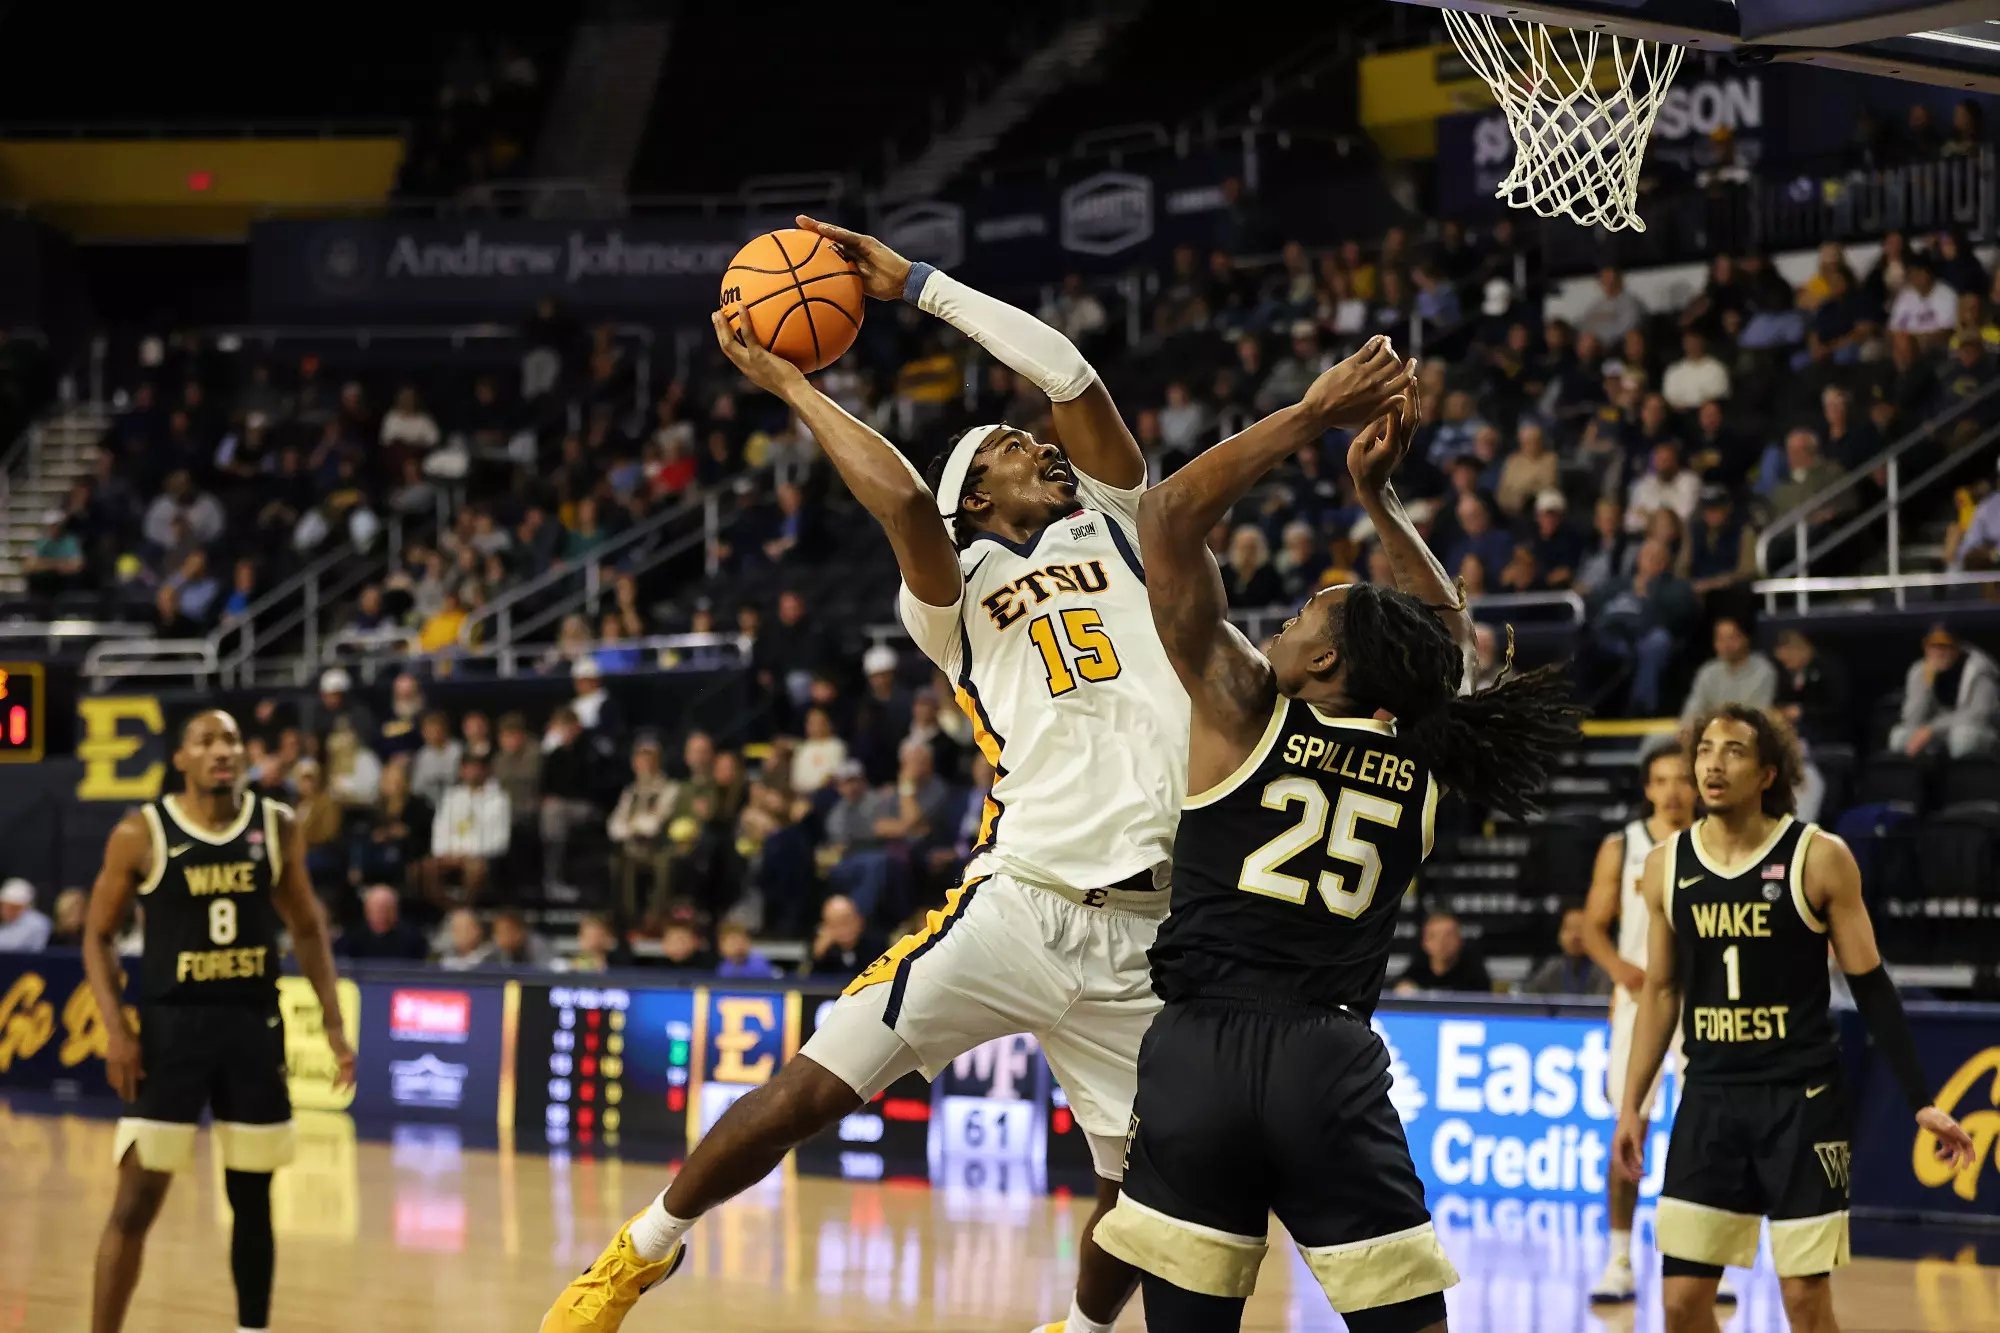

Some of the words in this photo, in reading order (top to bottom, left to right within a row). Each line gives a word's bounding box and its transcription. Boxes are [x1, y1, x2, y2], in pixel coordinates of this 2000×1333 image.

[386, 229, 562, 277] Andrew
[979, 560, 1109, 632] ETSU
[1028, 607, 1122, 698] 15
[76, 694, 166, 800] E
[1282, 733, 1416, 792] SPILLERS
[1237, 773, 1403, 920] 25
[183, 861, 257, 897] WAKE
[208, 897, 237, 945] 8
[1690, 902, 1773, 938] WAKE
[176, 945, 268, 984] FOREST
[1722, 945, 1741, 1001] 1
[1694, 1005, 1789, 1042] FOREST
[964, 1110, 1009, 1149] 61
[1431, 1118, 1607, 1194] Credit
